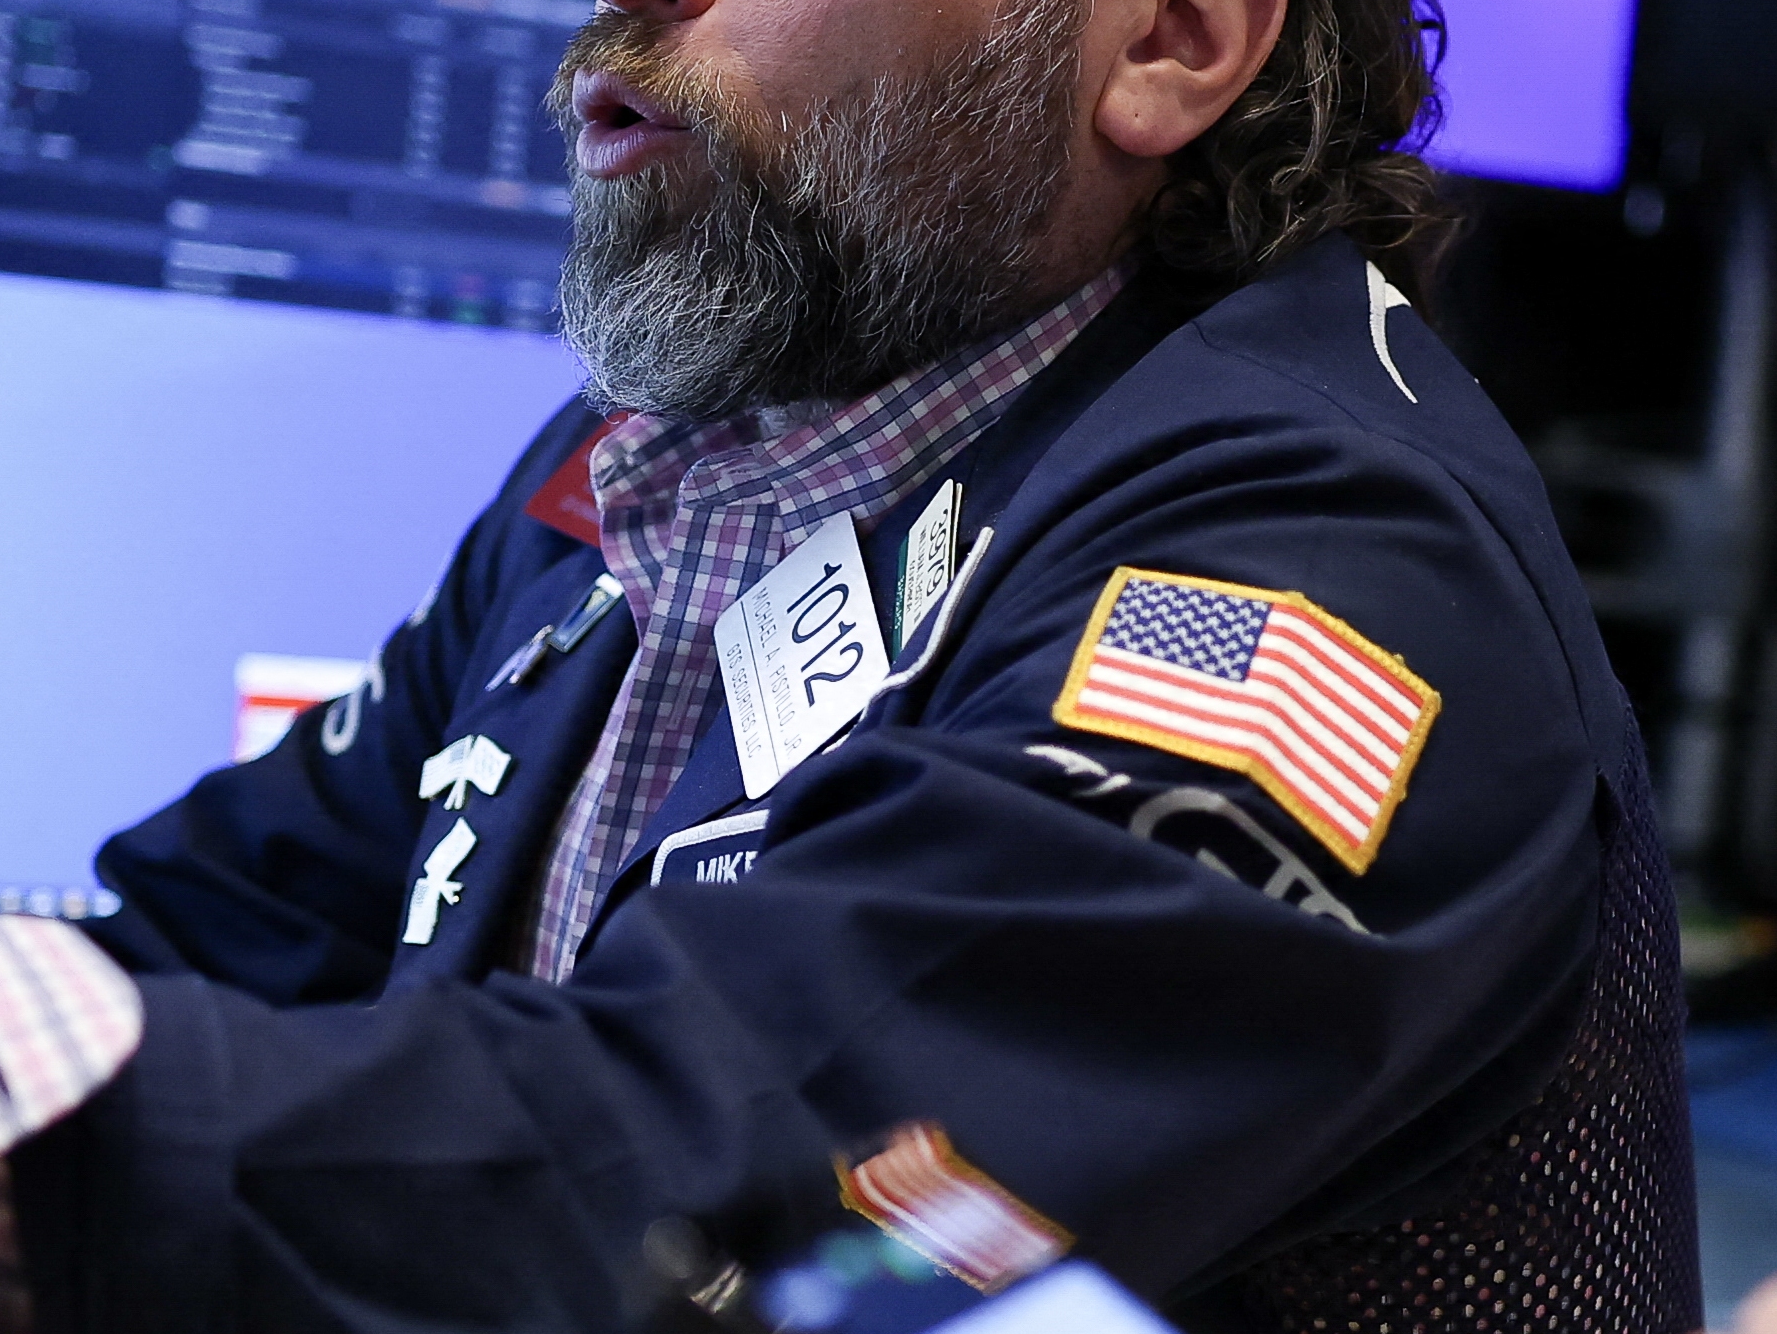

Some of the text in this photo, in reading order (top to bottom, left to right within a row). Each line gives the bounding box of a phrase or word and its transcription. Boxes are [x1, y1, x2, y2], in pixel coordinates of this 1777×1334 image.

[926, 508, 949, 598] 3979
[752, 586, 777, 649] MICHAEL
[786, 563, 864, 708] 1012
[726, 642, 762, 758] GTS SECURITIES LLC
